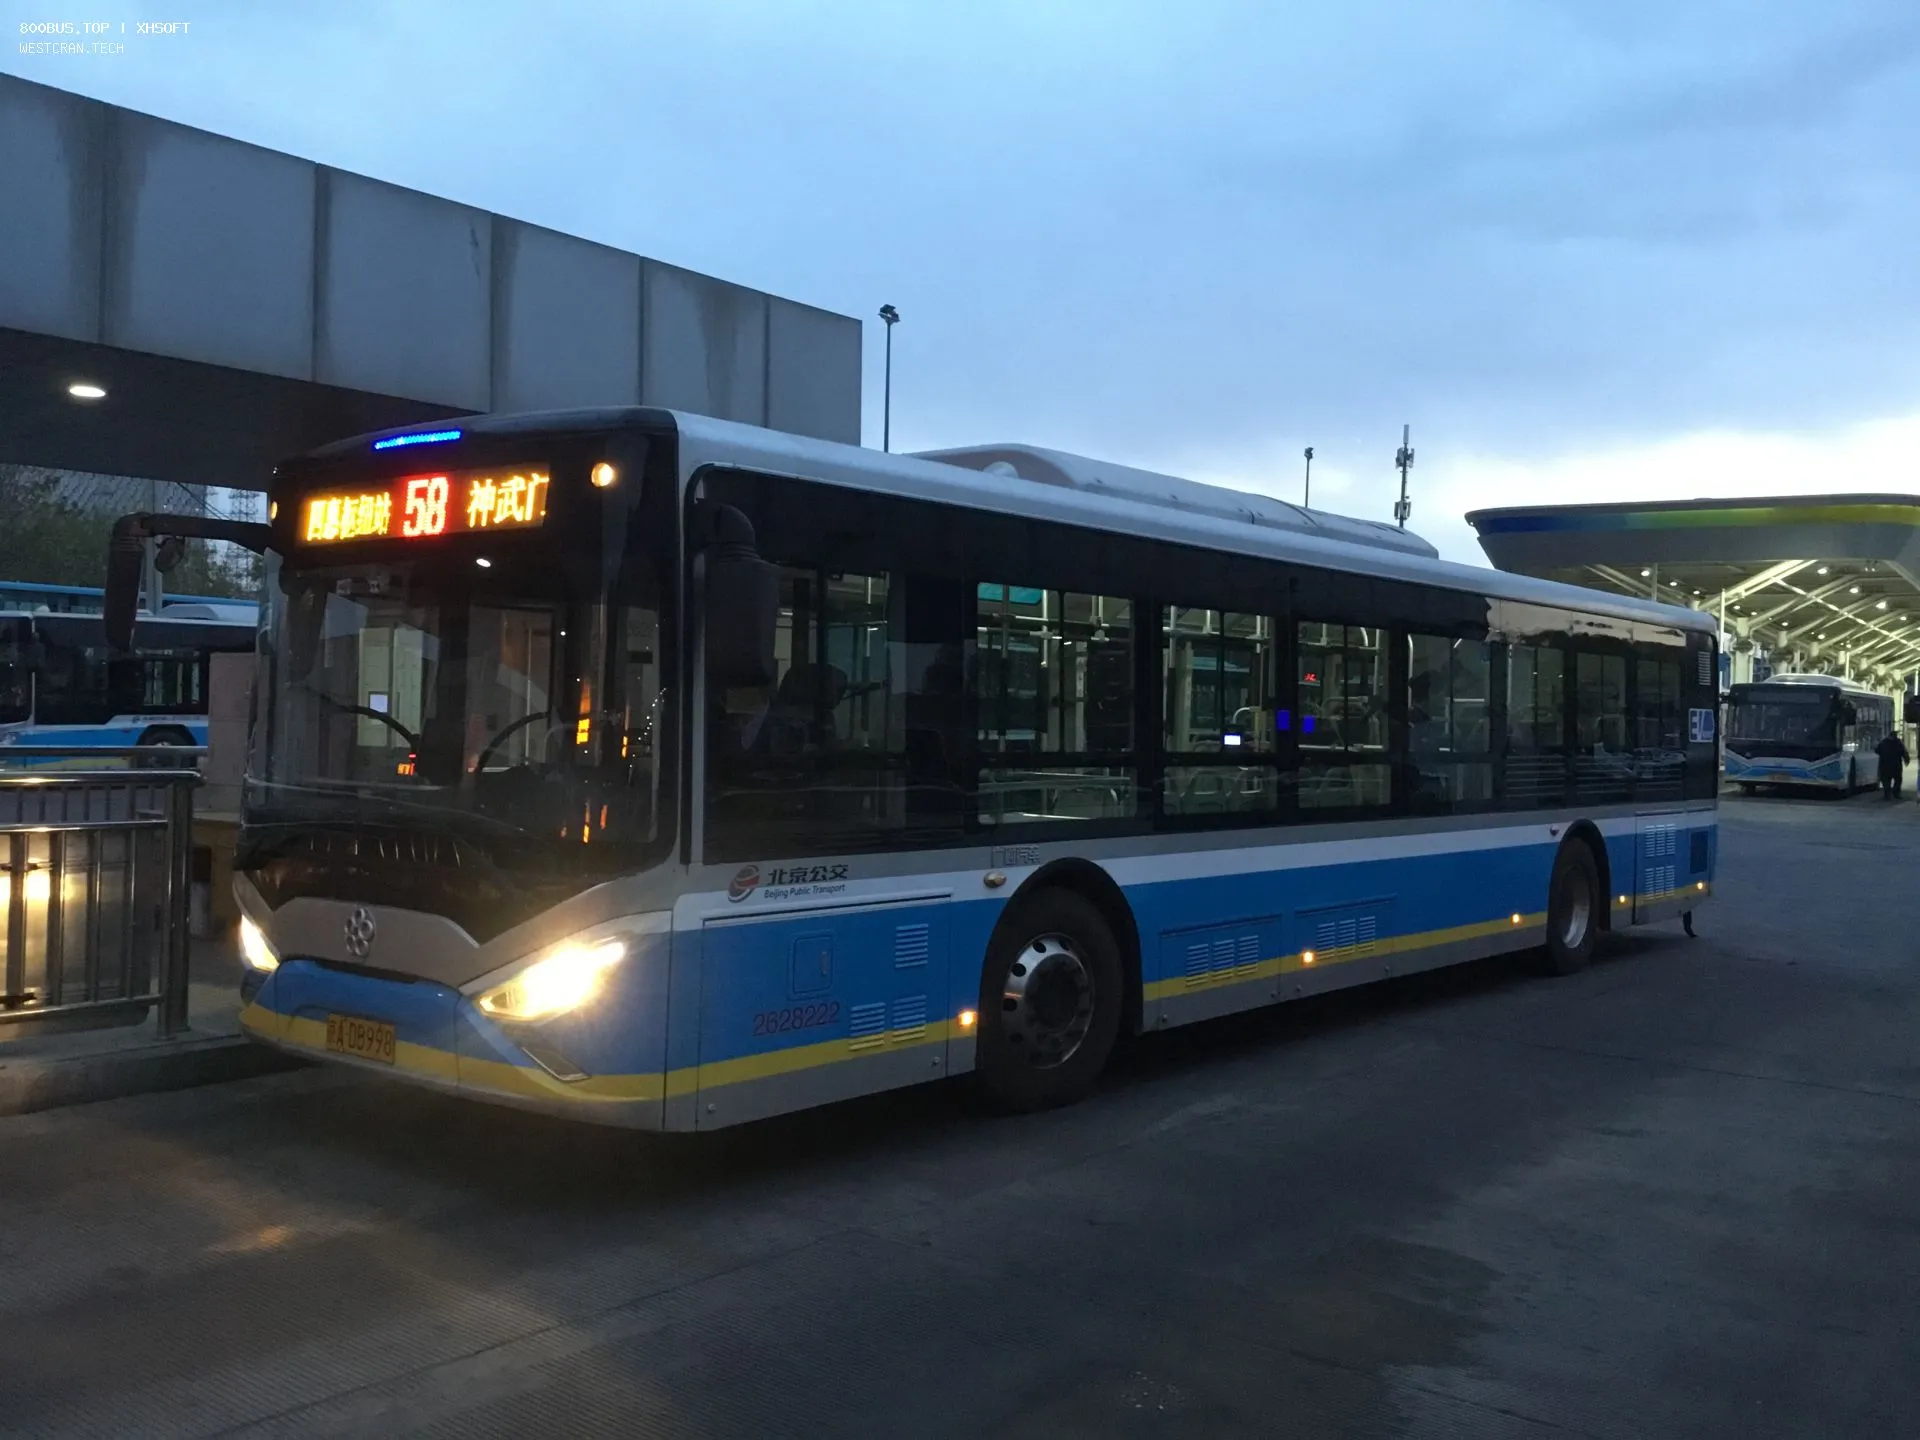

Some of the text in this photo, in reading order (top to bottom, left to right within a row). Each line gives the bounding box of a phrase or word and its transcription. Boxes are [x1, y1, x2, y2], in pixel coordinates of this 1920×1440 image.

[402, 475, 449, 538] 58
[766, 863, 849, 885] 北京公交
[764, 883, 846, 900] Beijing Public Transport
[753, 1000, 840, 1037] 2628222
